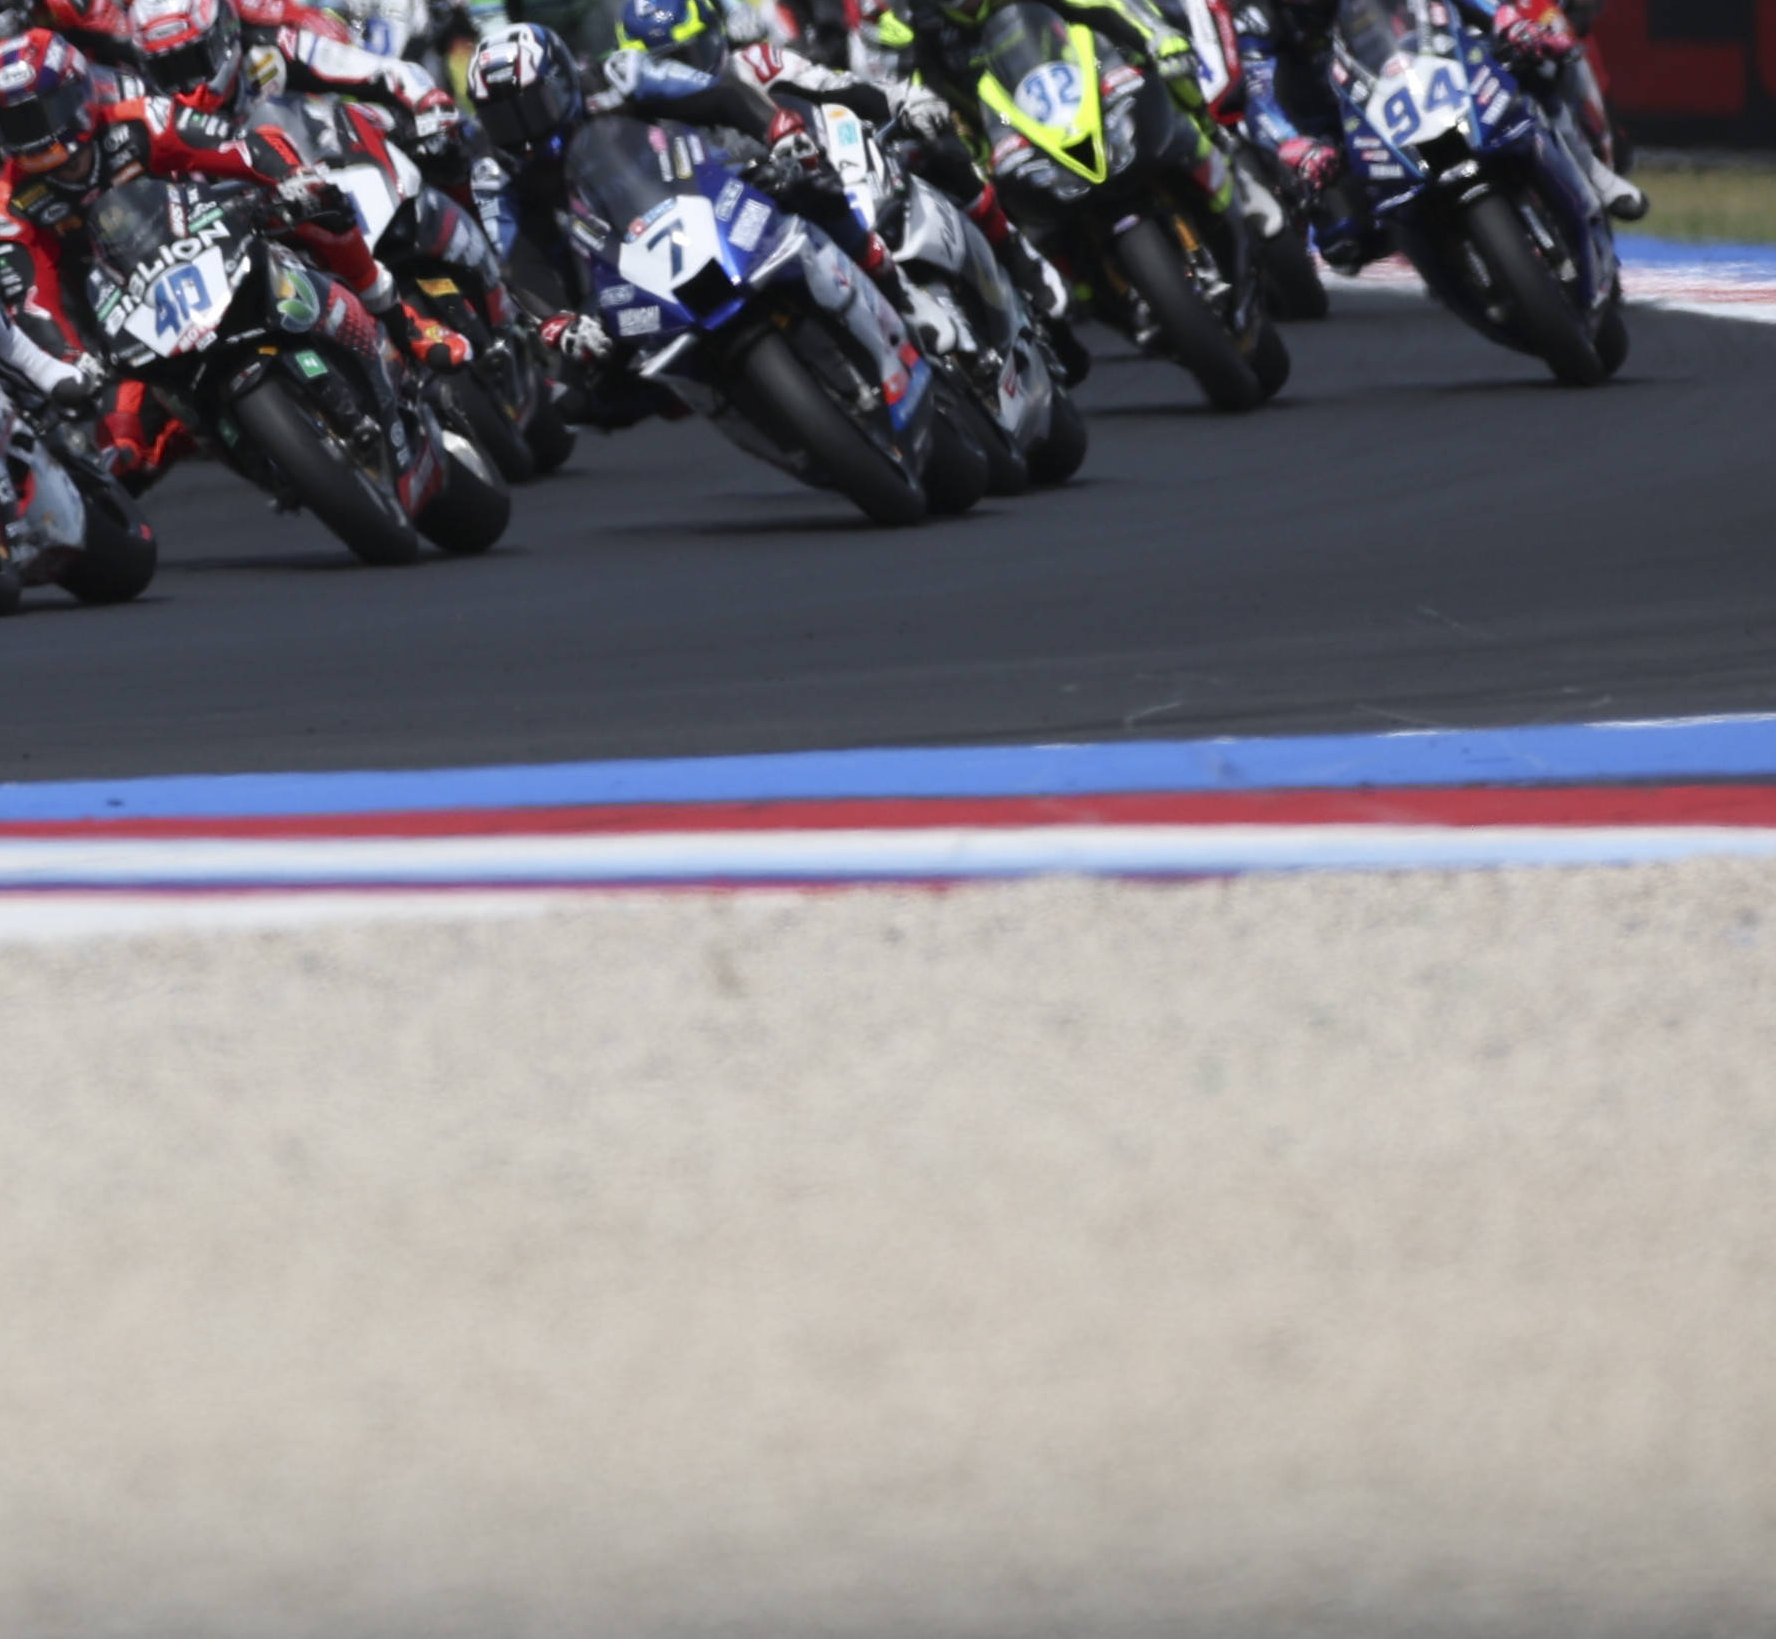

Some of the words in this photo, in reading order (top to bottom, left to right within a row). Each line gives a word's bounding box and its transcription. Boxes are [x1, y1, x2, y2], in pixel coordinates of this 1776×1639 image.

[1024, 64, 1082, 124] 32
[1384, 68, 1469, 148] 94
[647, 218, 686, 281] 7
[154, 264, 213, 339] 40
